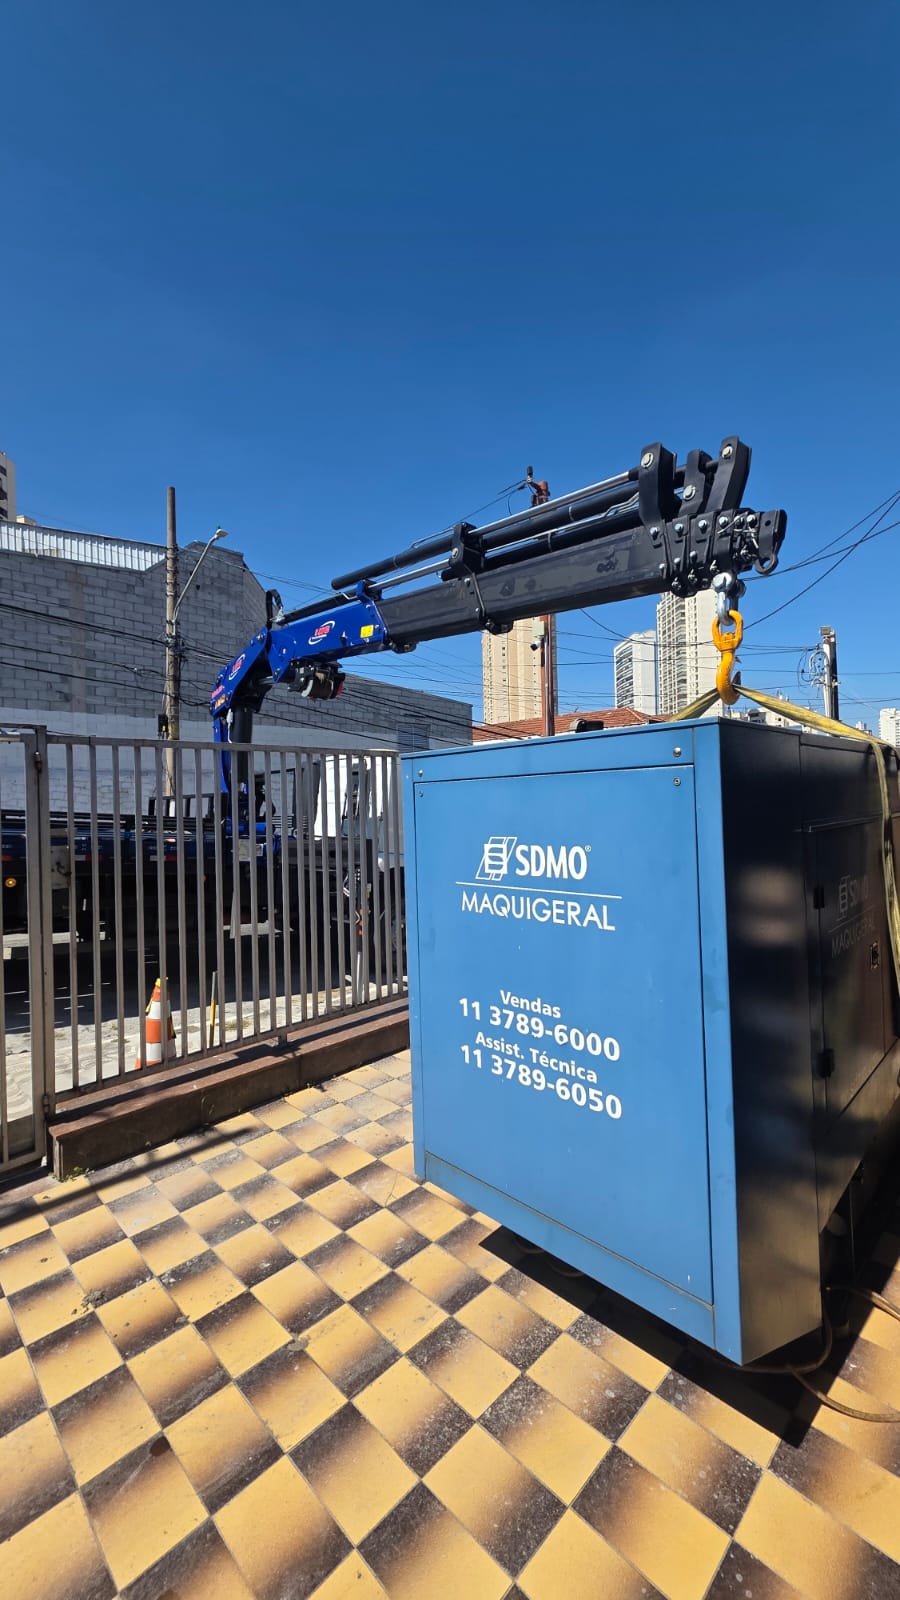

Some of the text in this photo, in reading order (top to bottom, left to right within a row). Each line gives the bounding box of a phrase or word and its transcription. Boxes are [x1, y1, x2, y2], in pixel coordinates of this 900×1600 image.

[515, 844, 588, 881] SDMO
[461, 890, 616, 932] MAQUIGERAL
[499, 989, 562, 1019] Vendas
[459, 997, 621, 1062] 11 3789-6000
[475, 1031, 598, 1084] Assist. Técnica
[460, 1044, 623, 1120] 11 3789-6050
